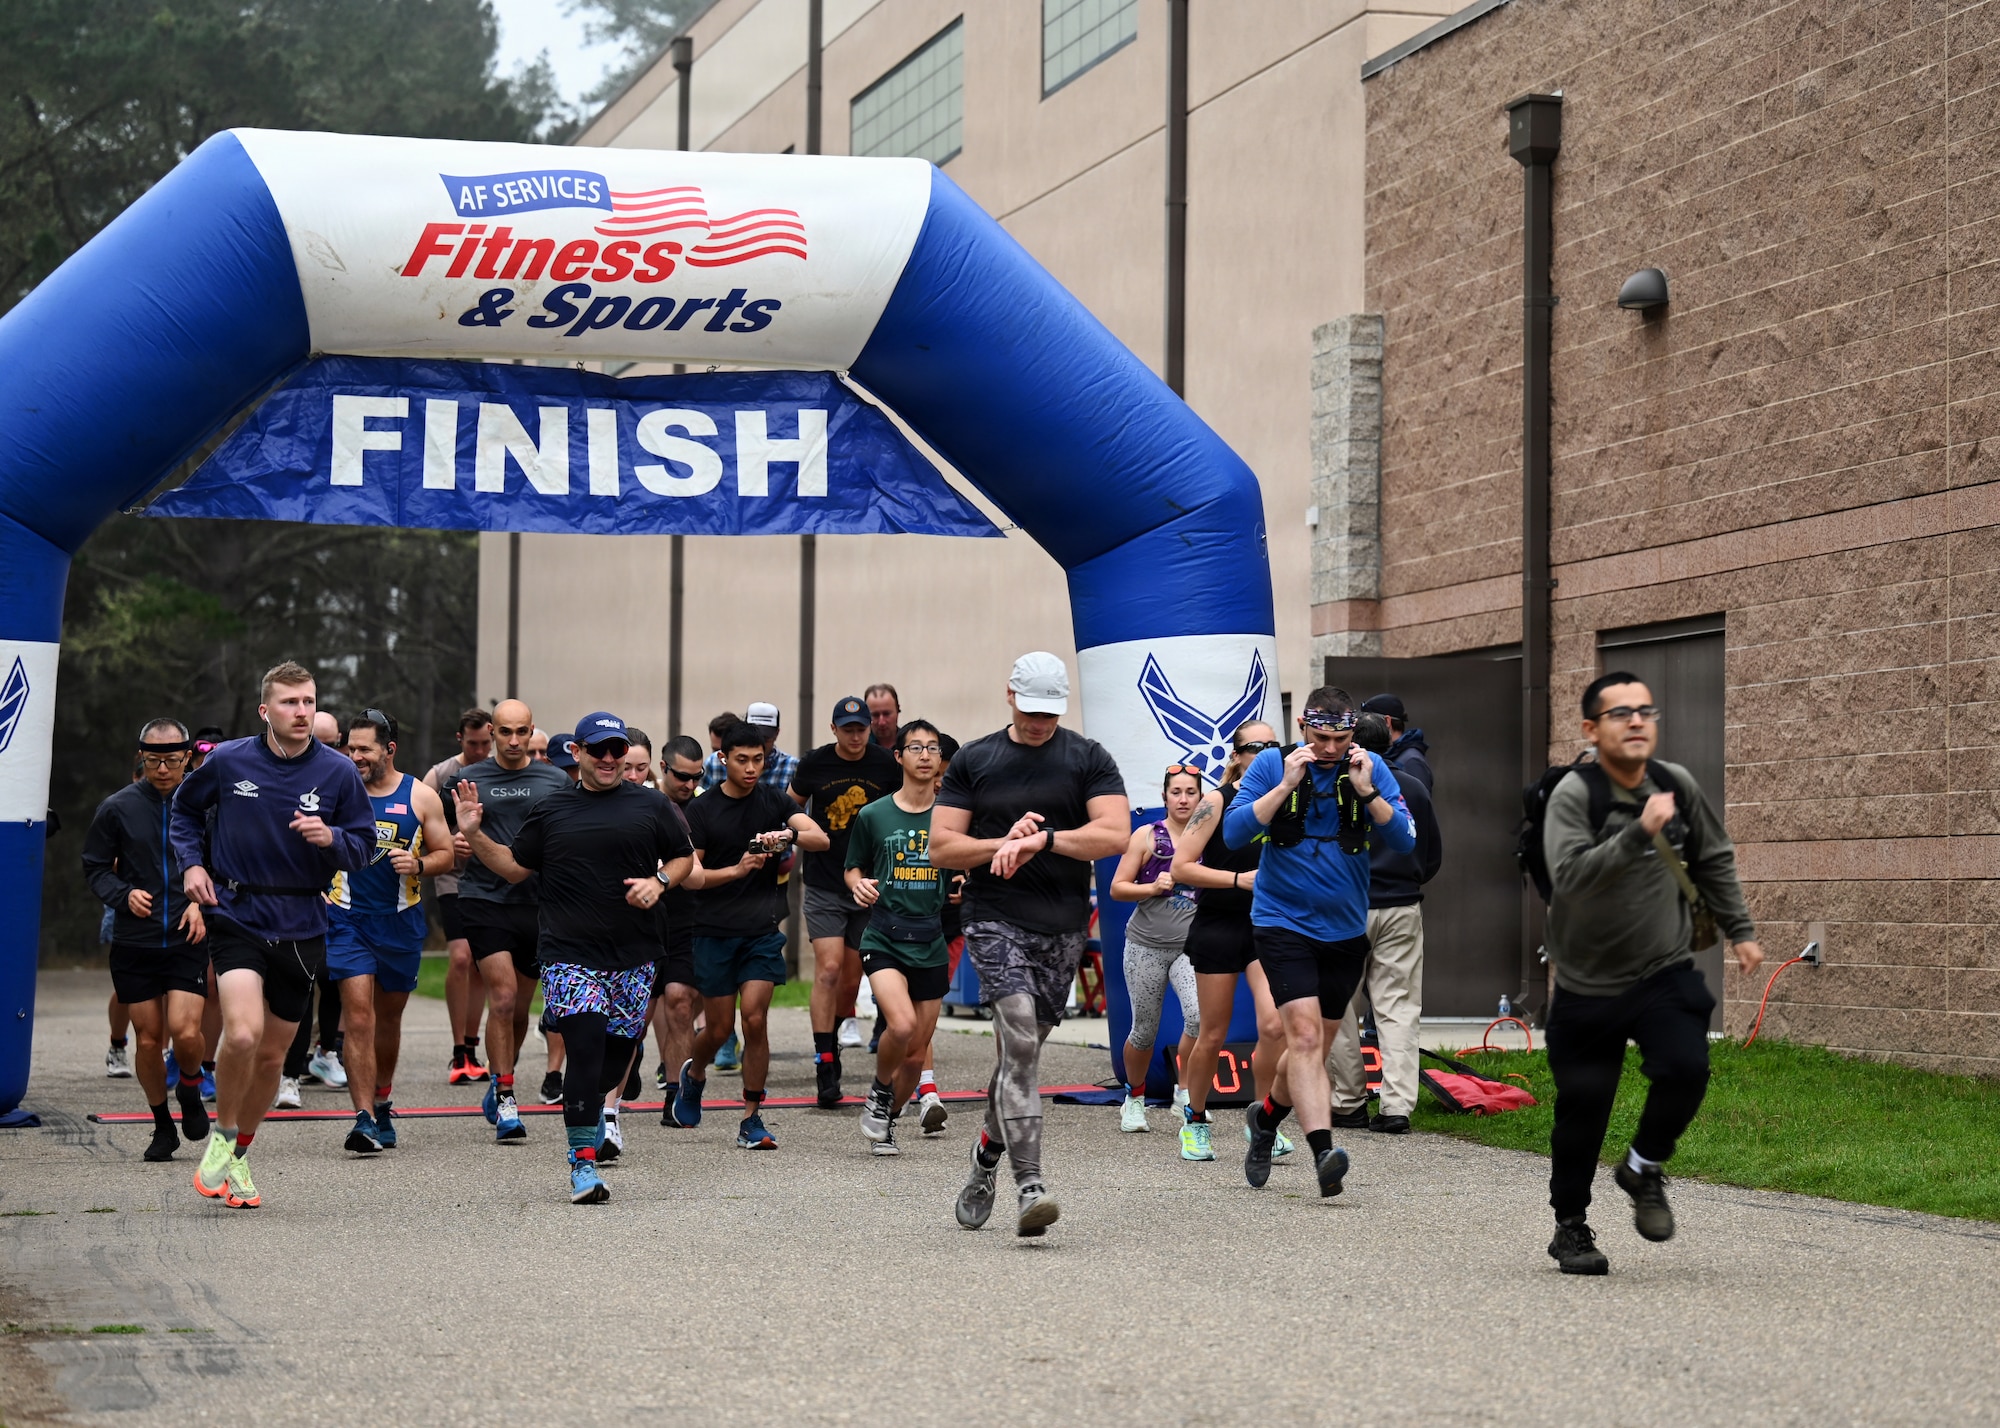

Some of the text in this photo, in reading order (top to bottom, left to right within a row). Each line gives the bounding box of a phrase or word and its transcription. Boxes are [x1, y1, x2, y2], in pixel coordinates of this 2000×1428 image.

[459, 176, 601, 210] AF SERVICES
[401, 222, 684, 284] Fitness
[457, 282, 782, 337] & Sports
[330, 394, 828, 497] FINISH
[893, 867, 939, 881] YOSEMITE
[893, 881, 908, 890] HALF
